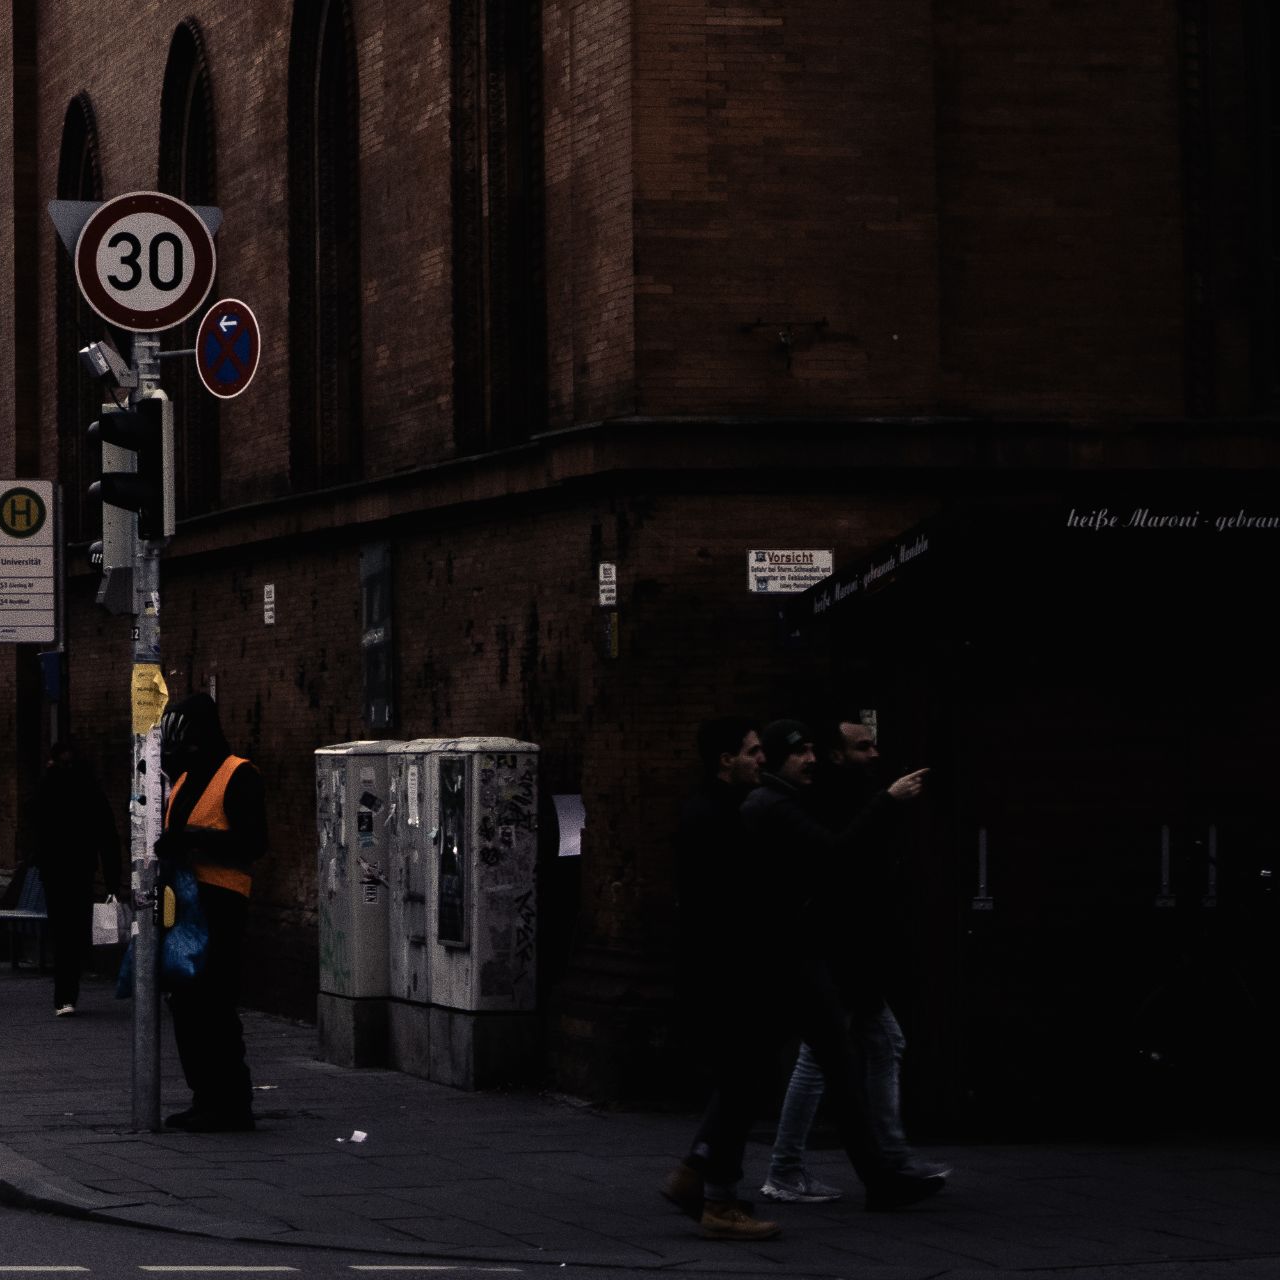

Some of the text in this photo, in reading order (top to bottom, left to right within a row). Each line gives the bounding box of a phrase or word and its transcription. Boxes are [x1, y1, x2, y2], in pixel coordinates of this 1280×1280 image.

[107, 231, 183, 291] 30
[11, 498, 31, 527] H
[1066, 508, 1119, 531] heiße
[1121, 508, 1200, 529] Maroni
[1, 557, 41, 566] Universität
[767, 551, 814, 563] Vorsicht
